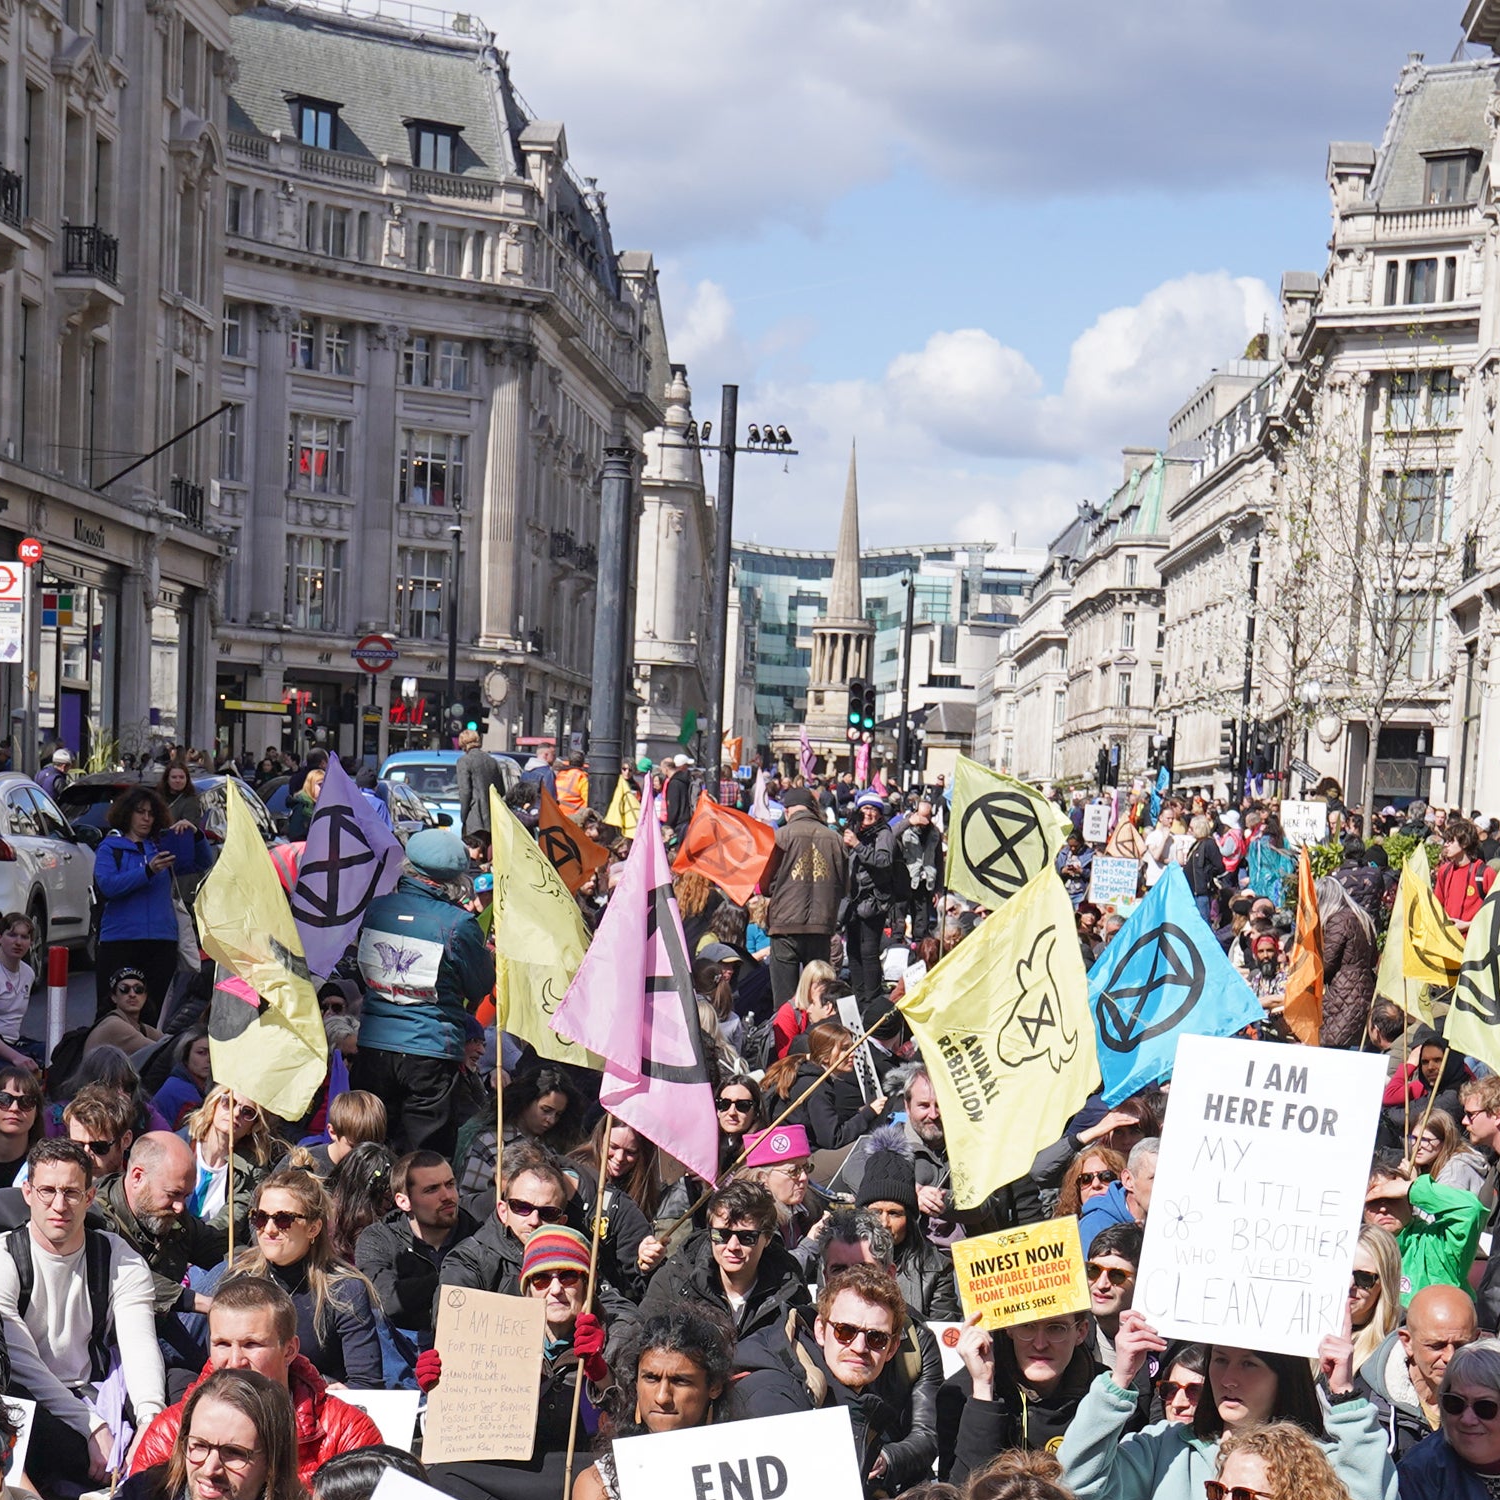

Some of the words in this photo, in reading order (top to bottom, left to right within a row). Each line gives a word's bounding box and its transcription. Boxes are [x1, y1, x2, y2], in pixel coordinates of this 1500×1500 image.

[74, 516, 106, 550] Microsoft
[21, 545, 39, 557] RC
[351, 650, 398, 659] UNDERGROUND
[936, 1034, 985, 1123] REBELLION
[960, 1034, 1001, 1106] ANIMAL
[1244, 1060, 1256, 1088] I
[1262, 1063, 1309, 1095] AM
[1203, 1093, 1274, 1128] HERE
[1281, 1103, 1339, 1137] FOR
[1192, 1135, 1253, 1173] MY
[1216, 1180, 1342, 1217] LITTLE
[1230, 1217, 1349, 1260] BROTHER
[969, 1251, 1021, 1278] INVEST
[1025, 1241, 1065, 1265] NOW
[1174, 1246, 1217, 1266] WHO
[1240, 1255, 1313, 1279] NEEDS
[968, 1267, 1029, 1293] RENEWABLE
[1031, 1258, 1073, 1277] ENERGY
[975, 1288, 1006, 1305] HOME
[1007, 1273, 1072, 1298] INSULATION
[993, 1307, 1002, 1318] IT
[1003, 1299, 1031, 1316] MAKES
[1031, 1295, 1057, 1309] SENSE
[1145, 1267, 1274, 1329] CLEAN
[453, 1310, 461, 1332] I
[468, 1311, 490, 1339] AM
[495, 1313, 532, 1338] HERE
[447, 1339, 466, 1354] FOR
[470, 1342, 487, 1358] THE
[490, 1344, 533, 1361] FUTURE
[441, 1413, 470, 1424] FOSSIL
